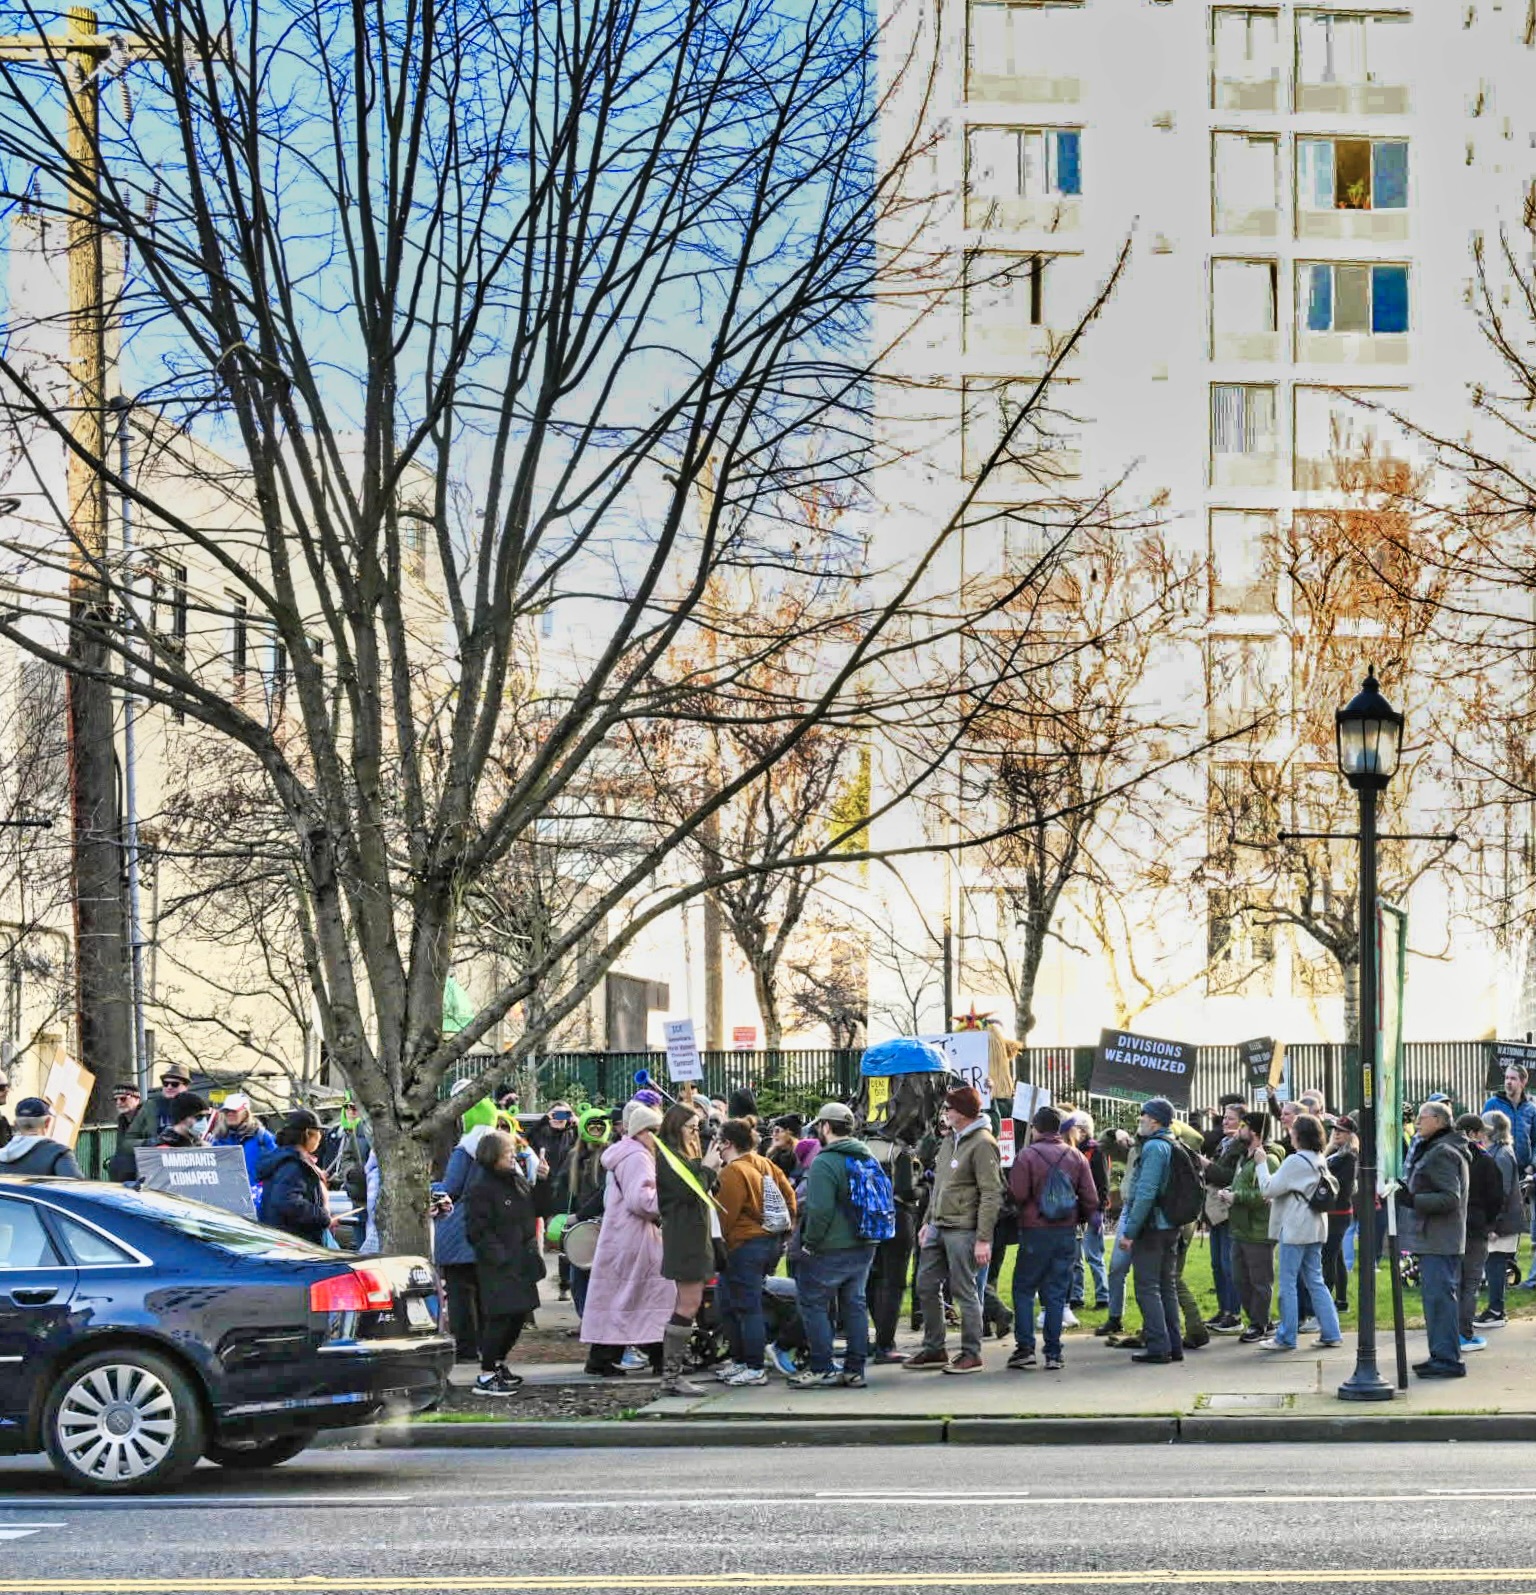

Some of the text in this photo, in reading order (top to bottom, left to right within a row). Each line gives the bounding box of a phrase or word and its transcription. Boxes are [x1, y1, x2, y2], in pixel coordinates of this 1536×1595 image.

[1118, 1035, 1182, 1058] DIVISIONS
[1104, 1048, 1187, 1074] WEAPONIZED
[161, 1152, 217, 1167] IMMIGRANTS
[169, 1170, 219, 1186] KIDNAPPED
